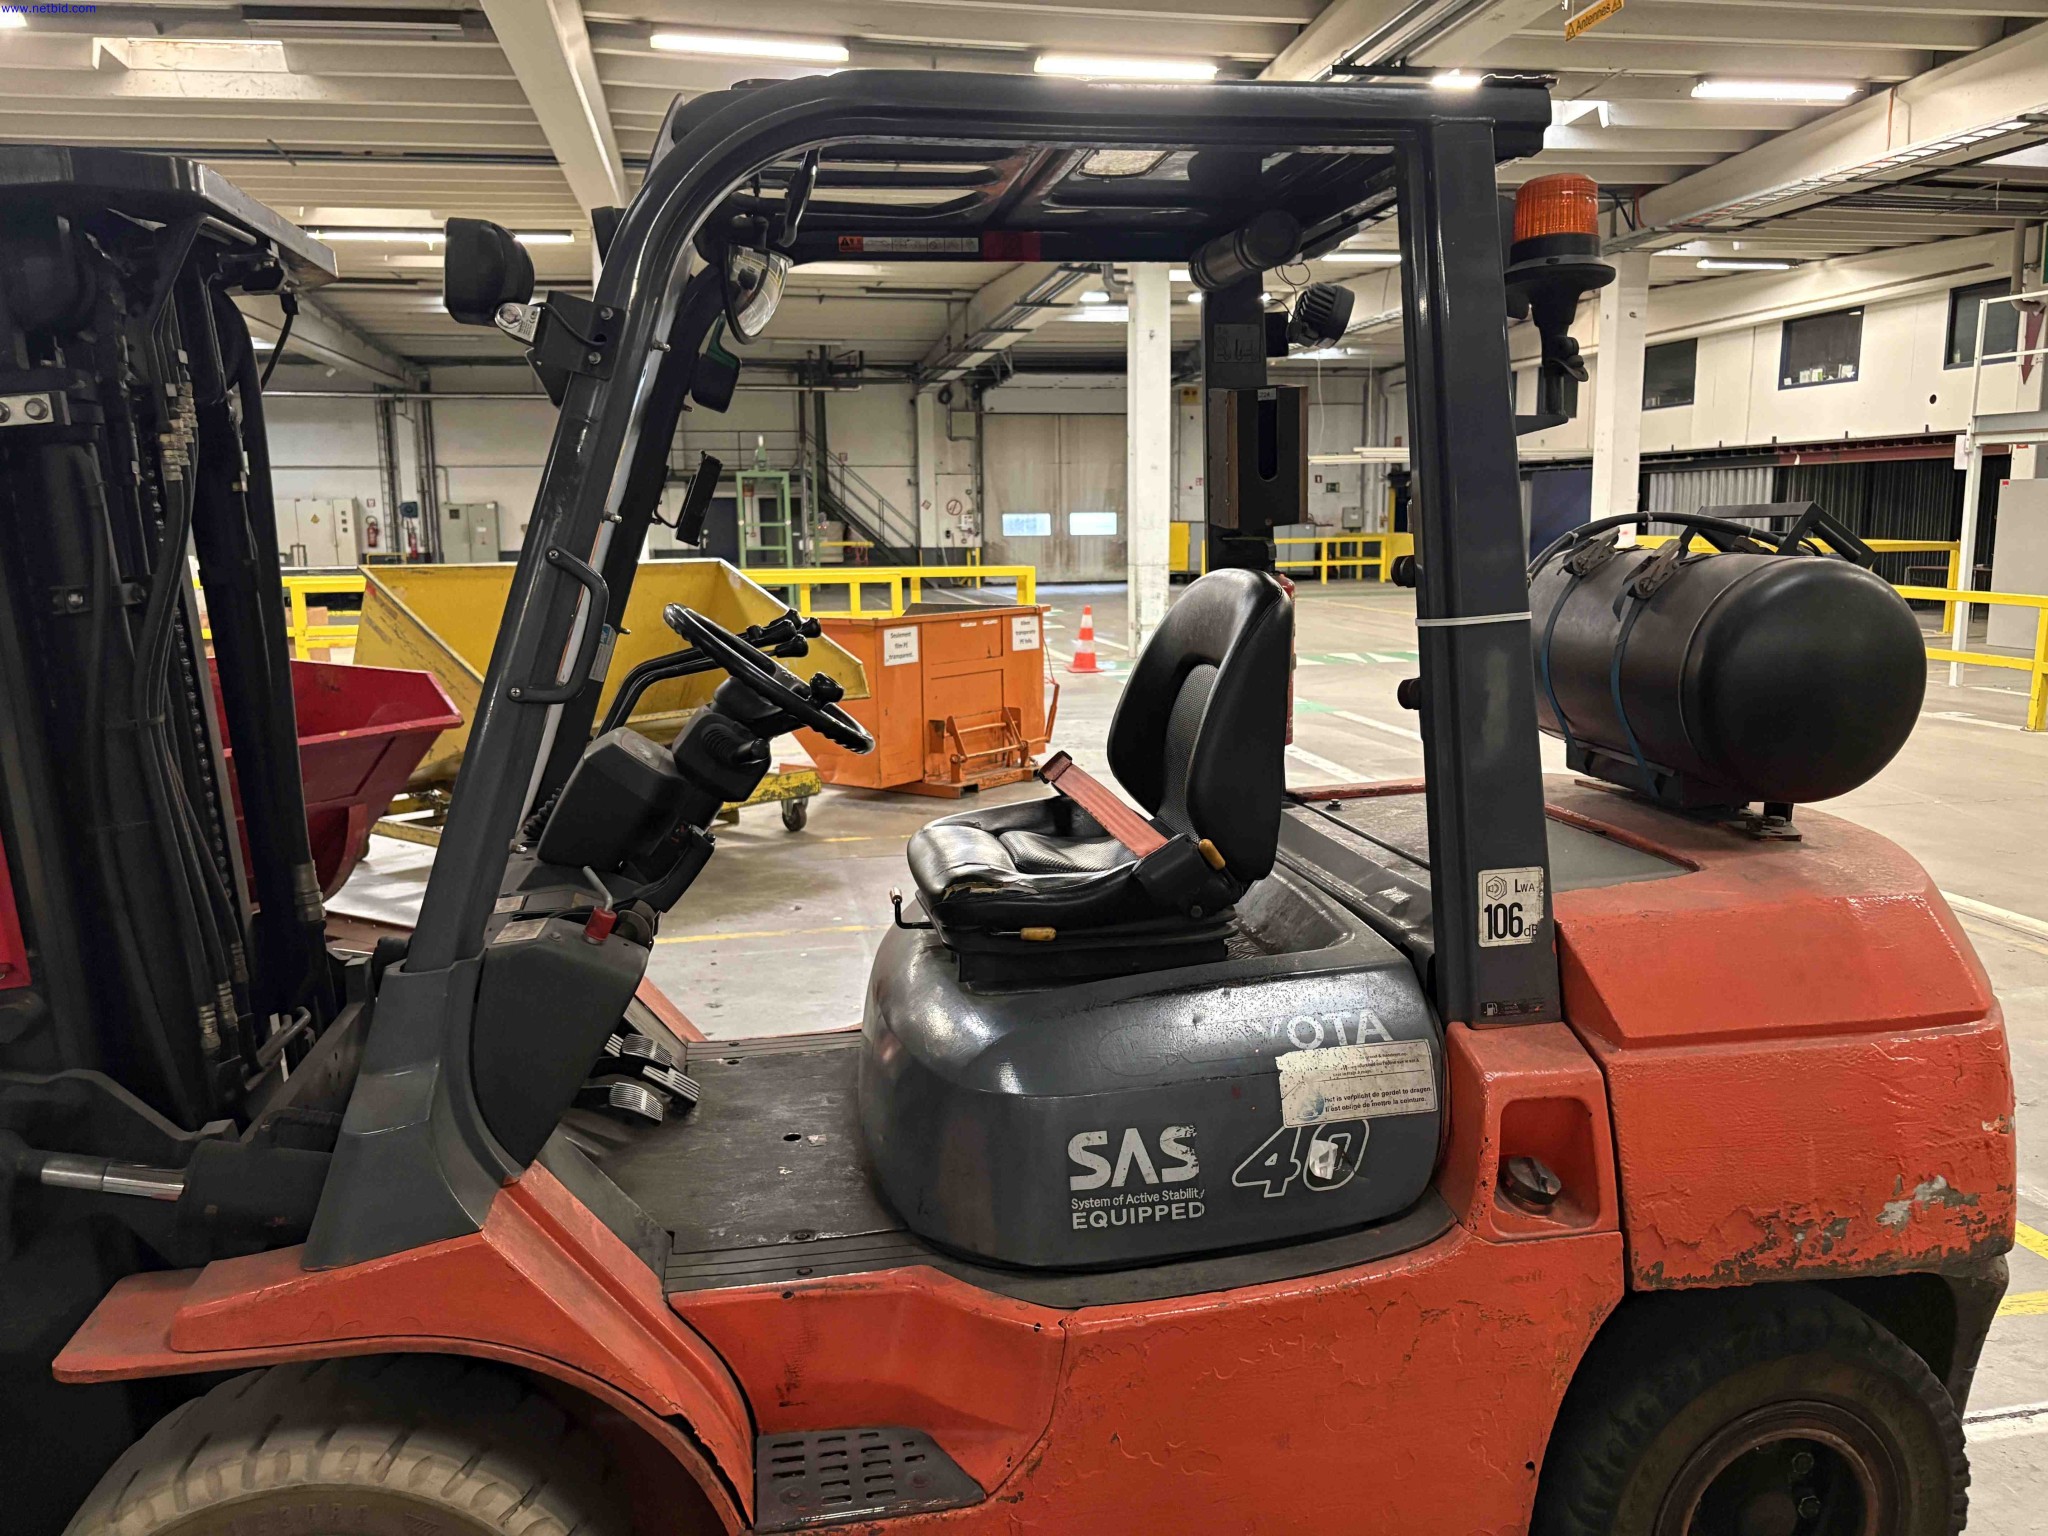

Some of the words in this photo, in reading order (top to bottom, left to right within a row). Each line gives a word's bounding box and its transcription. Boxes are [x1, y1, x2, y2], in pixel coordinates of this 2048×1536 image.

[1576, 3, 1611, 31] Antennes
[1484, 902, 1524, 940] 106
[1343, 1092, 1371, 1101] verplicht
[1381, 1088, 1401, 1098] gordel
[1410, 1086, 1432, 1094] dragen.
[1067, 1123, 1199, 1191] SAS
[1232, 1119, 1370, 1198] 40
[1071, 1197, 1111, 1211] System
[1112, 1193, 1124, 1206] of
[1125, 1191, 1160, 1205] Active
[1072, 1201, 1206, 1230] EQUIPPED
